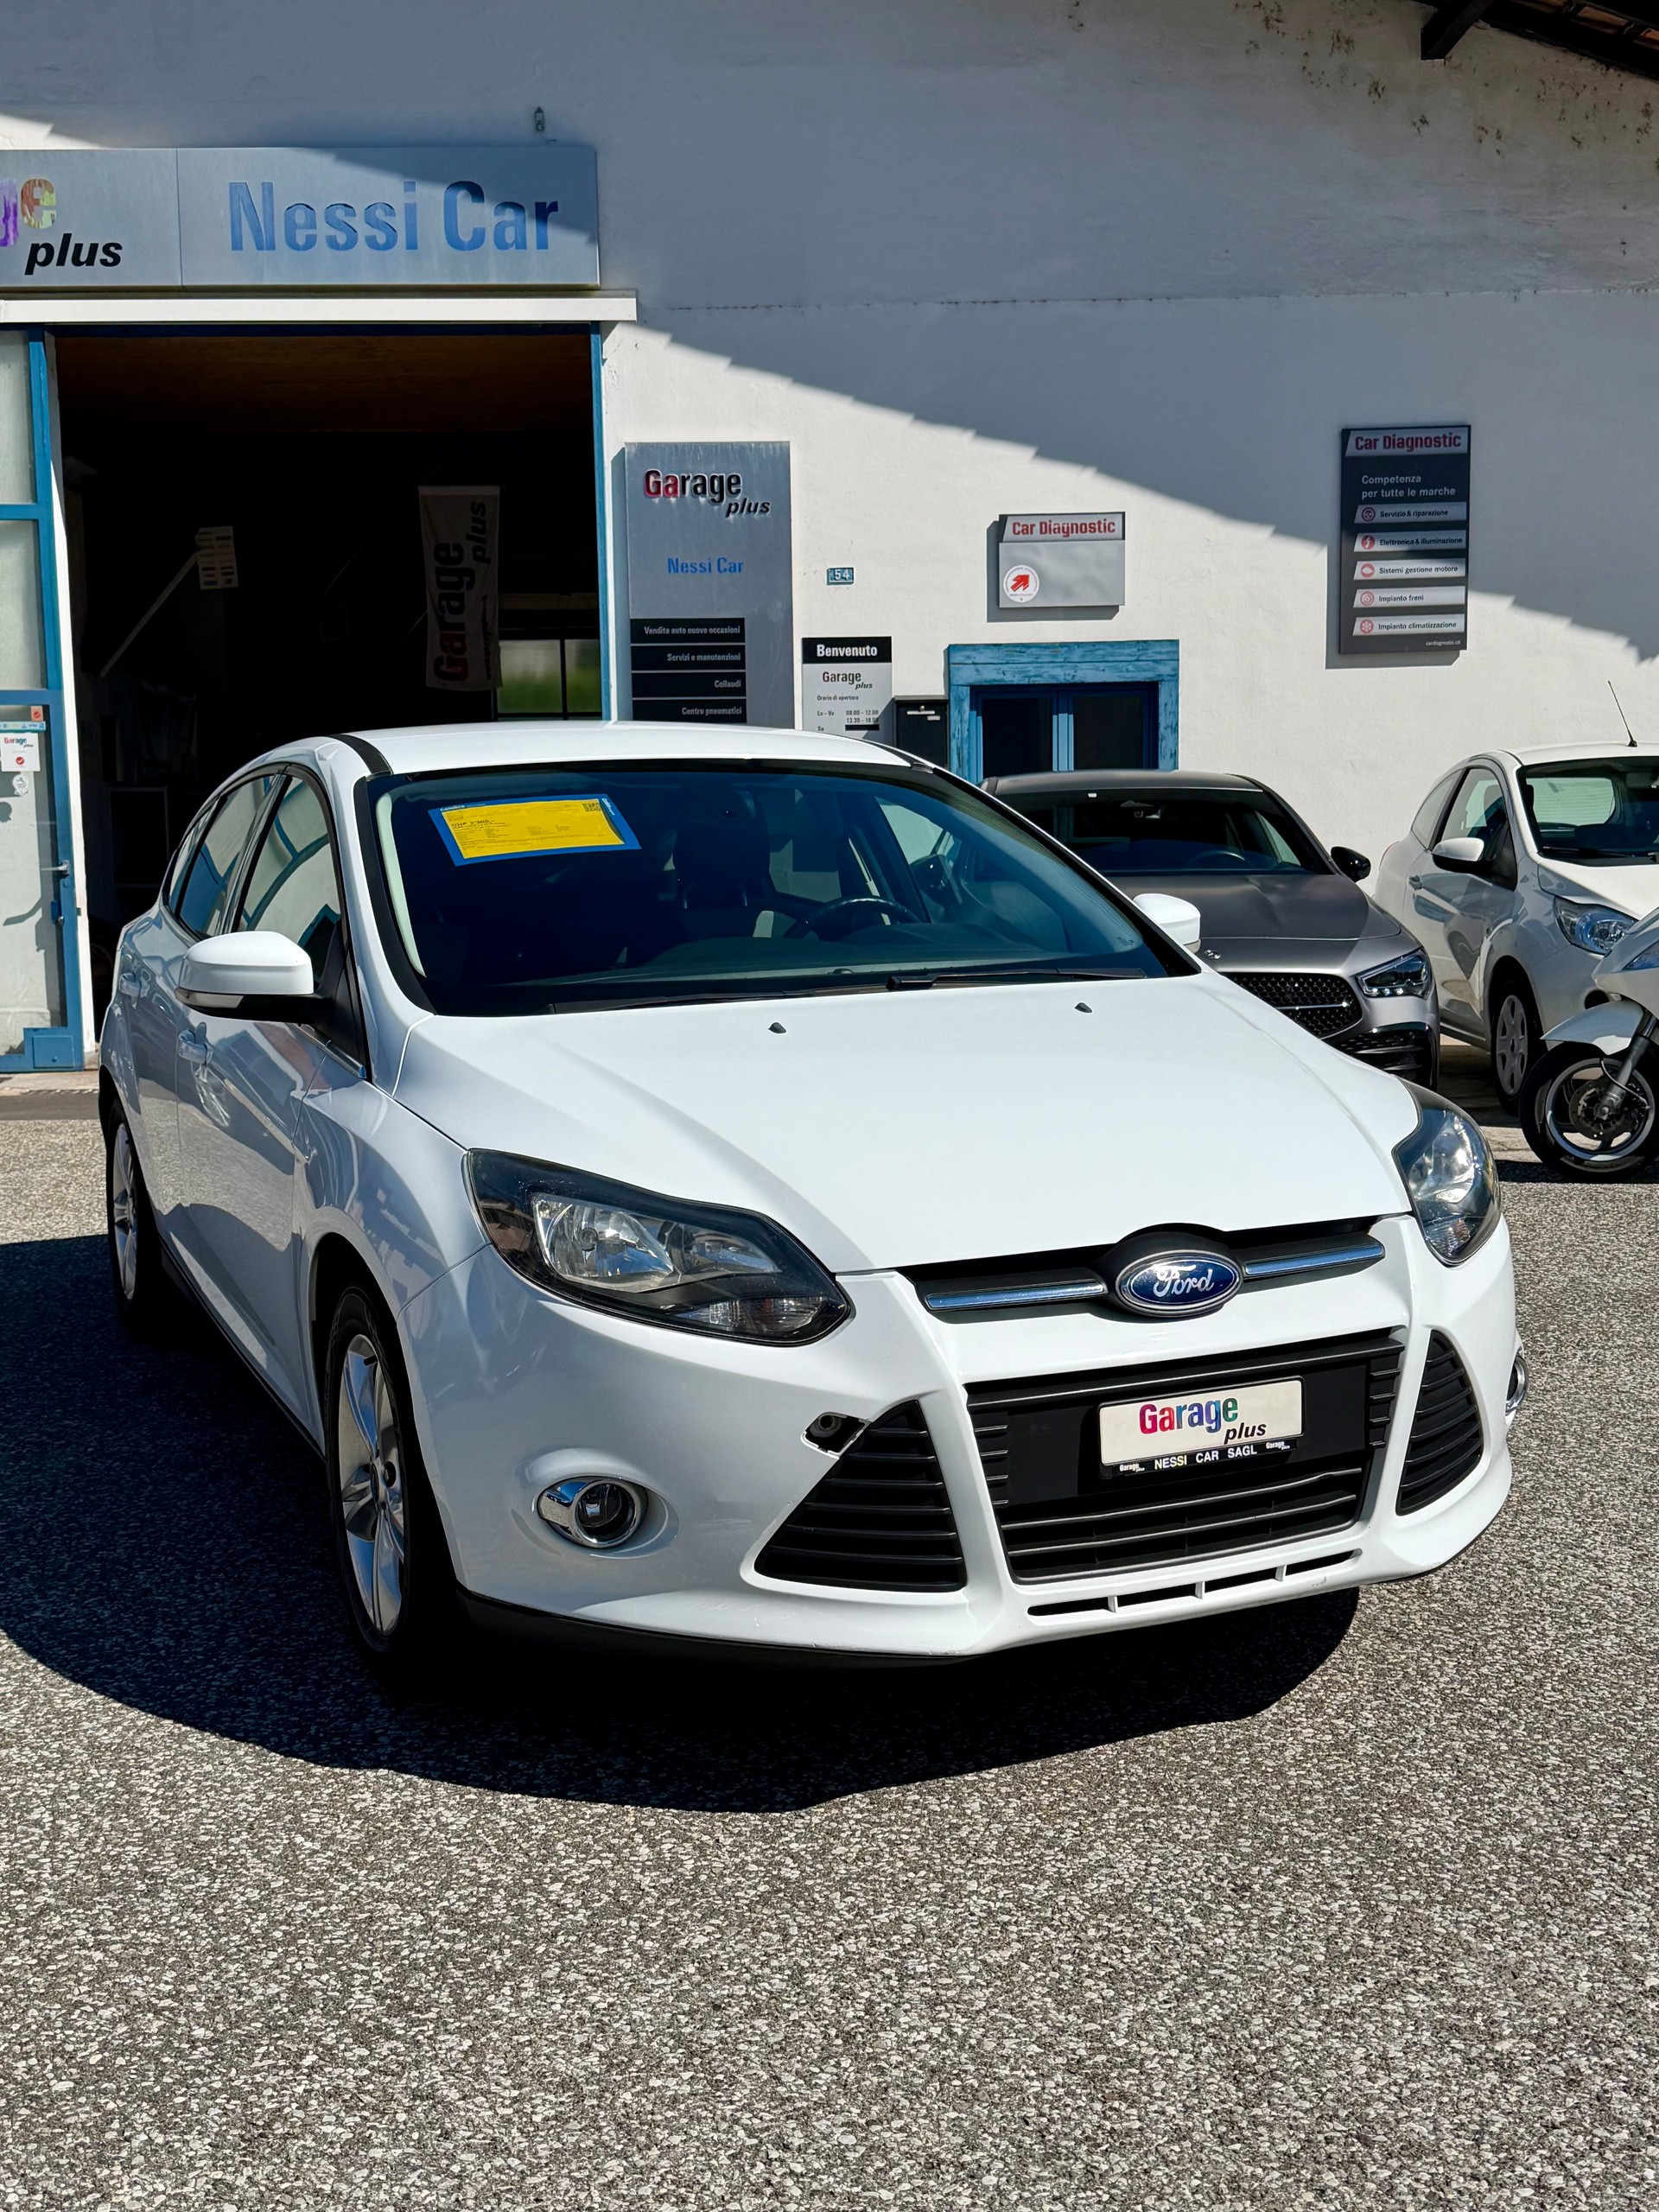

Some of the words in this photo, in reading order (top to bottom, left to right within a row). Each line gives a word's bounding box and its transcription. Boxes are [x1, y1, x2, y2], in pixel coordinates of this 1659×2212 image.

[228, 180, 418, 251] Nessi
[443, 180, 559, 251] Car
[24, 232, 123, 276] plus
[1355, 435, 1380, 450] Car
[1382, 432, 1462, 453] Diagnostic
[644, 468, 742, 504] Garage
[1361, 474, 1421, 486] Competenza
[1362, 490, 1378, 500] per
[1381, 488, 1405, 498] tutte
[1407, 487, 1417, 497] le
[1419, 486, 1456, 497] marche
[725, 499, 772, 518] plus
[1413, 509, 1449, 518] riparazione
[466, 501, 491, 565] plus
[1012, 521, 1036, 536] Car
[1039, 518, 1116, 538] Diagnostic
[1421, 537, 1463, 545] illuminazione
[667, 556, 712, 575] Nessi
[716, 556, 744, 575] Car
[1405, 566, 1433, 575] gestione
[833, 569, 850, 581] 54
[1378, 594, 1408, 603] Impianto
[433, 542, 475, 682] Garage
[644, 626, 670, 635] Vendita
[671, 626, 687, 635] auto
[709, 625, 741, 634] occasioni
[1378, 622, 1407, 631] Impianto
[1408, 621, 1457, 630] climatizzazione
[666, 652, 690, 662] Servizi
[696, 652, 741, 661] manutenzioni
[816, 644, 878, 658] Benvenuto
[714, 679, 741, 689] Collaudi
[822, 671, 861, 685] Garage
[855, 682, 874, 690] plus
[681, 707, 704, 715] Centro
[705, 706, 743, 717] pneumatici
[4, 737, 27, 746] Garage
[1153, 1263, 1215, 1298] Ford
[1138, 1397, 1239, 1435] Garage
[1224, 1422, 1267, 1445] plus
[1266, 1440, 1286, 1451] Garage
[1154, 1454, 1187, 1471] NESSI
[1195, 1450, 1219, 1464] CAR
[1227, 1444, 1258, 1459] SAGL
[1118, 1462, 1140, 1472] Garage
